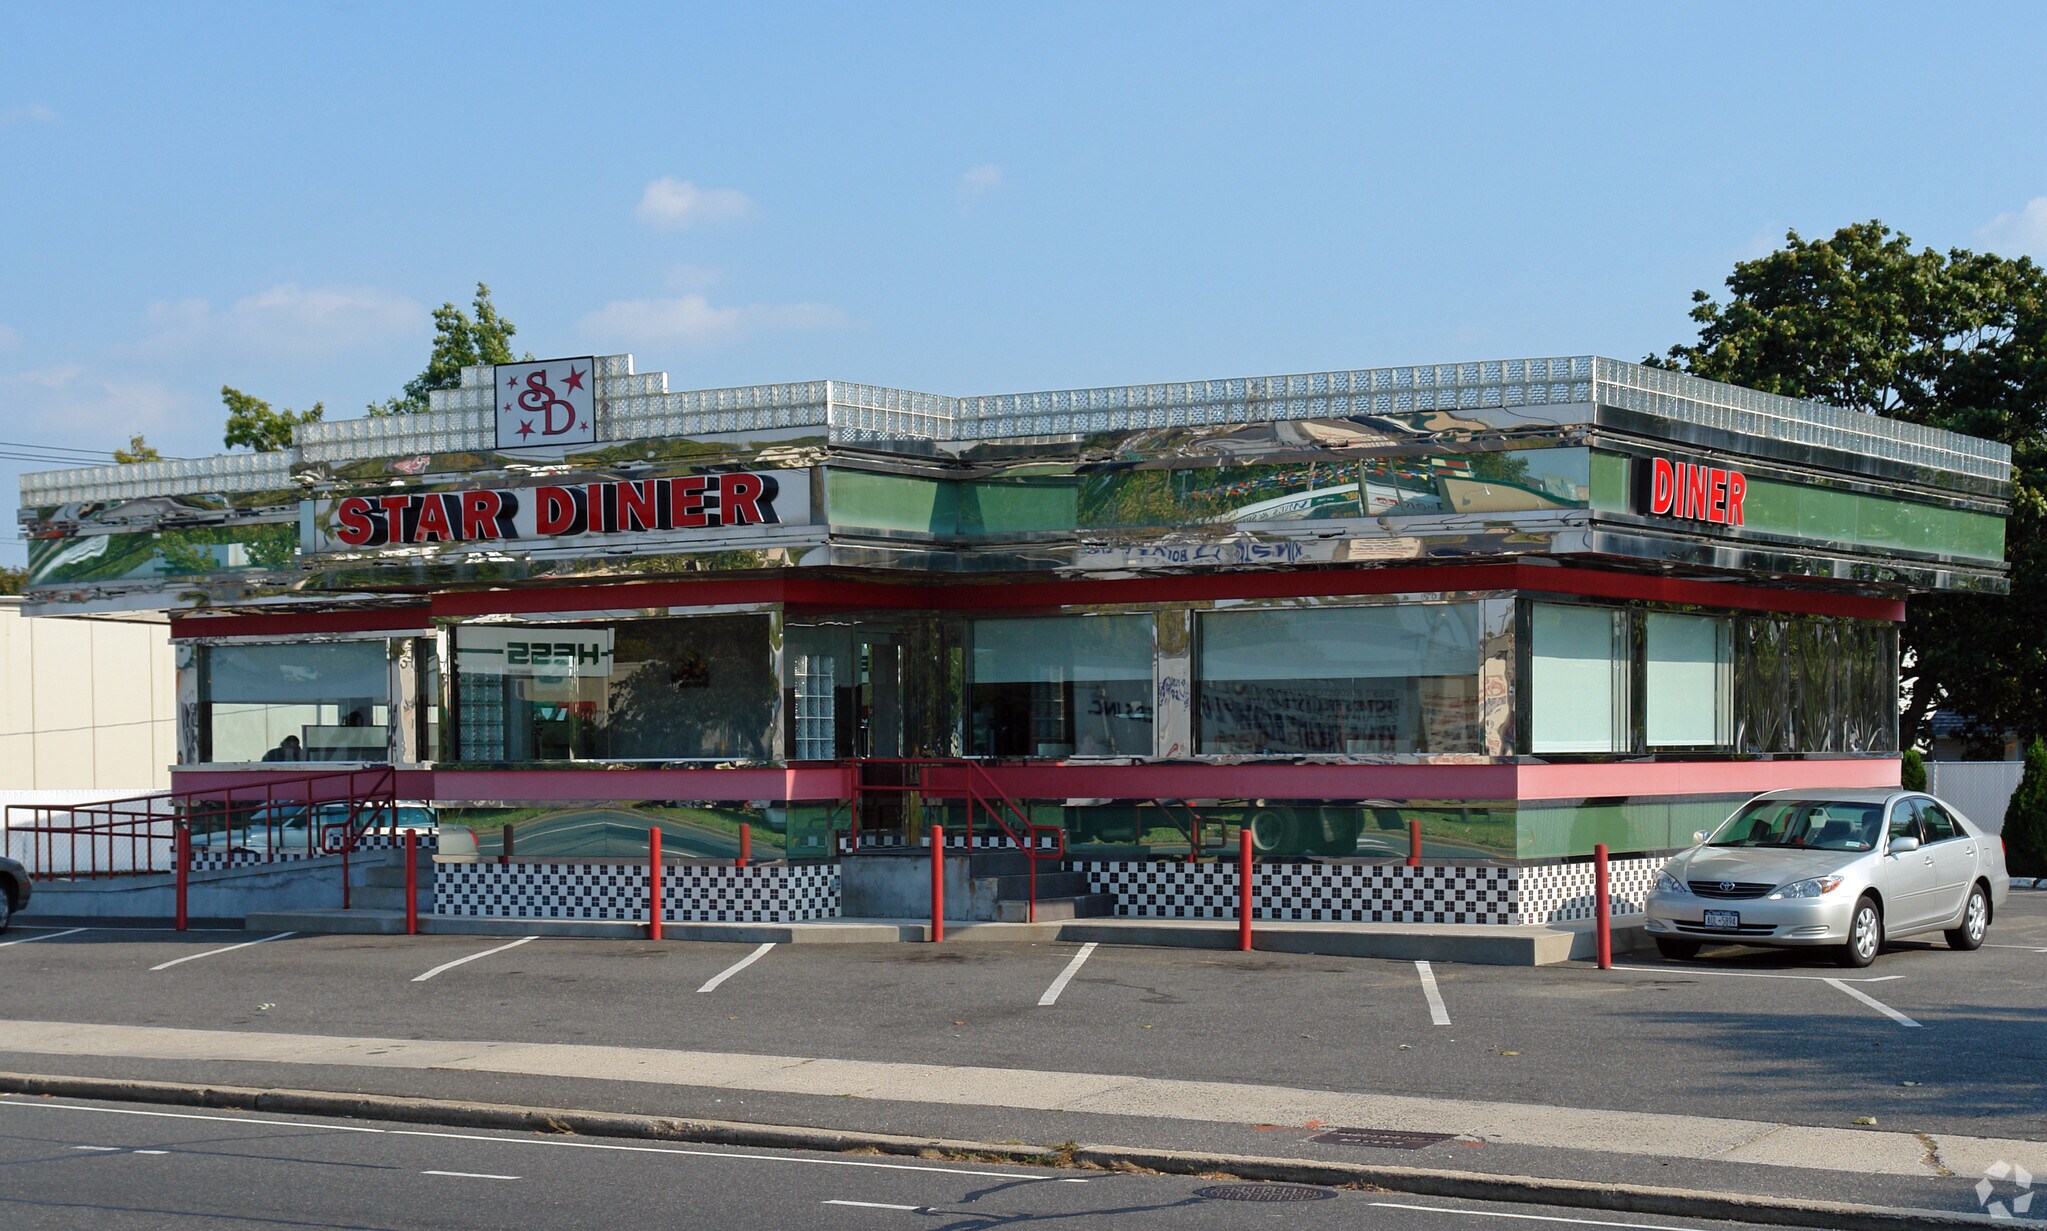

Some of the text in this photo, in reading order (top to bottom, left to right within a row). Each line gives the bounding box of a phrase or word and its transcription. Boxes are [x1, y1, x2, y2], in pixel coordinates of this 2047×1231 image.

[336, 473, 765, 545] STAR DINER
[1651, 457, 1747, 527] DINER
